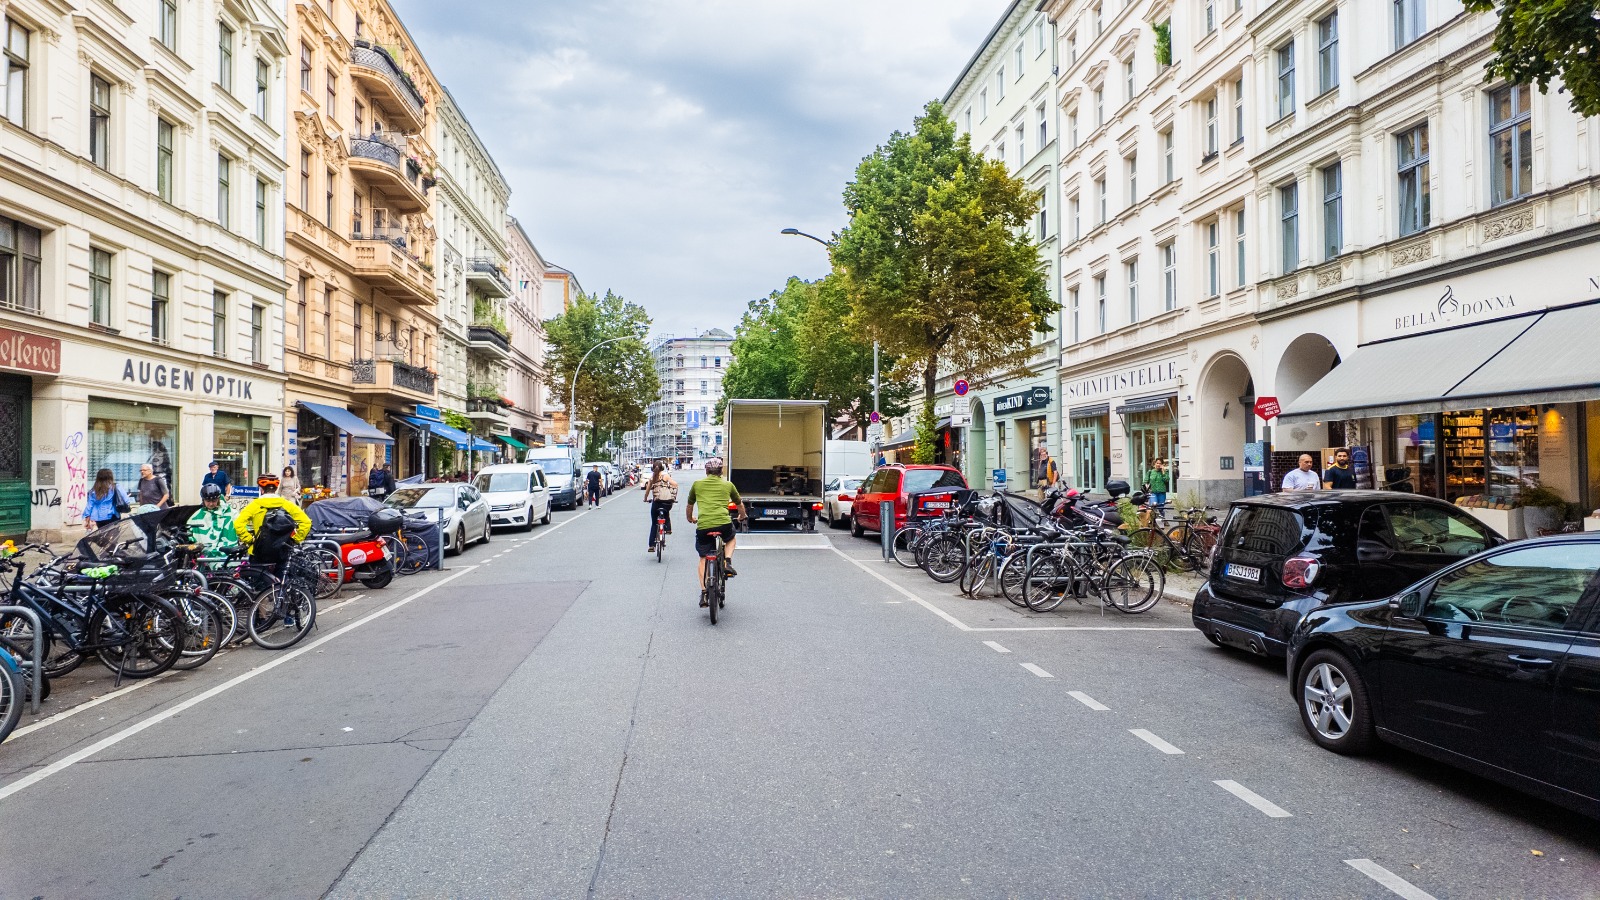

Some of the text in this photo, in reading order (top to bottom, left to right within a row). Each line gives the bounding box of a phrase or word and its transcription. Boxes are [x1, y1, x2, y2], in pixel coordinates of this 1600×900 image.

[1395, 294, 1516, 330] BELLA DONNA
[122, 358, 253, 400] AUGEN OPTIK
[1069, 361, 1177, 398] SCHNITTSTELLE
